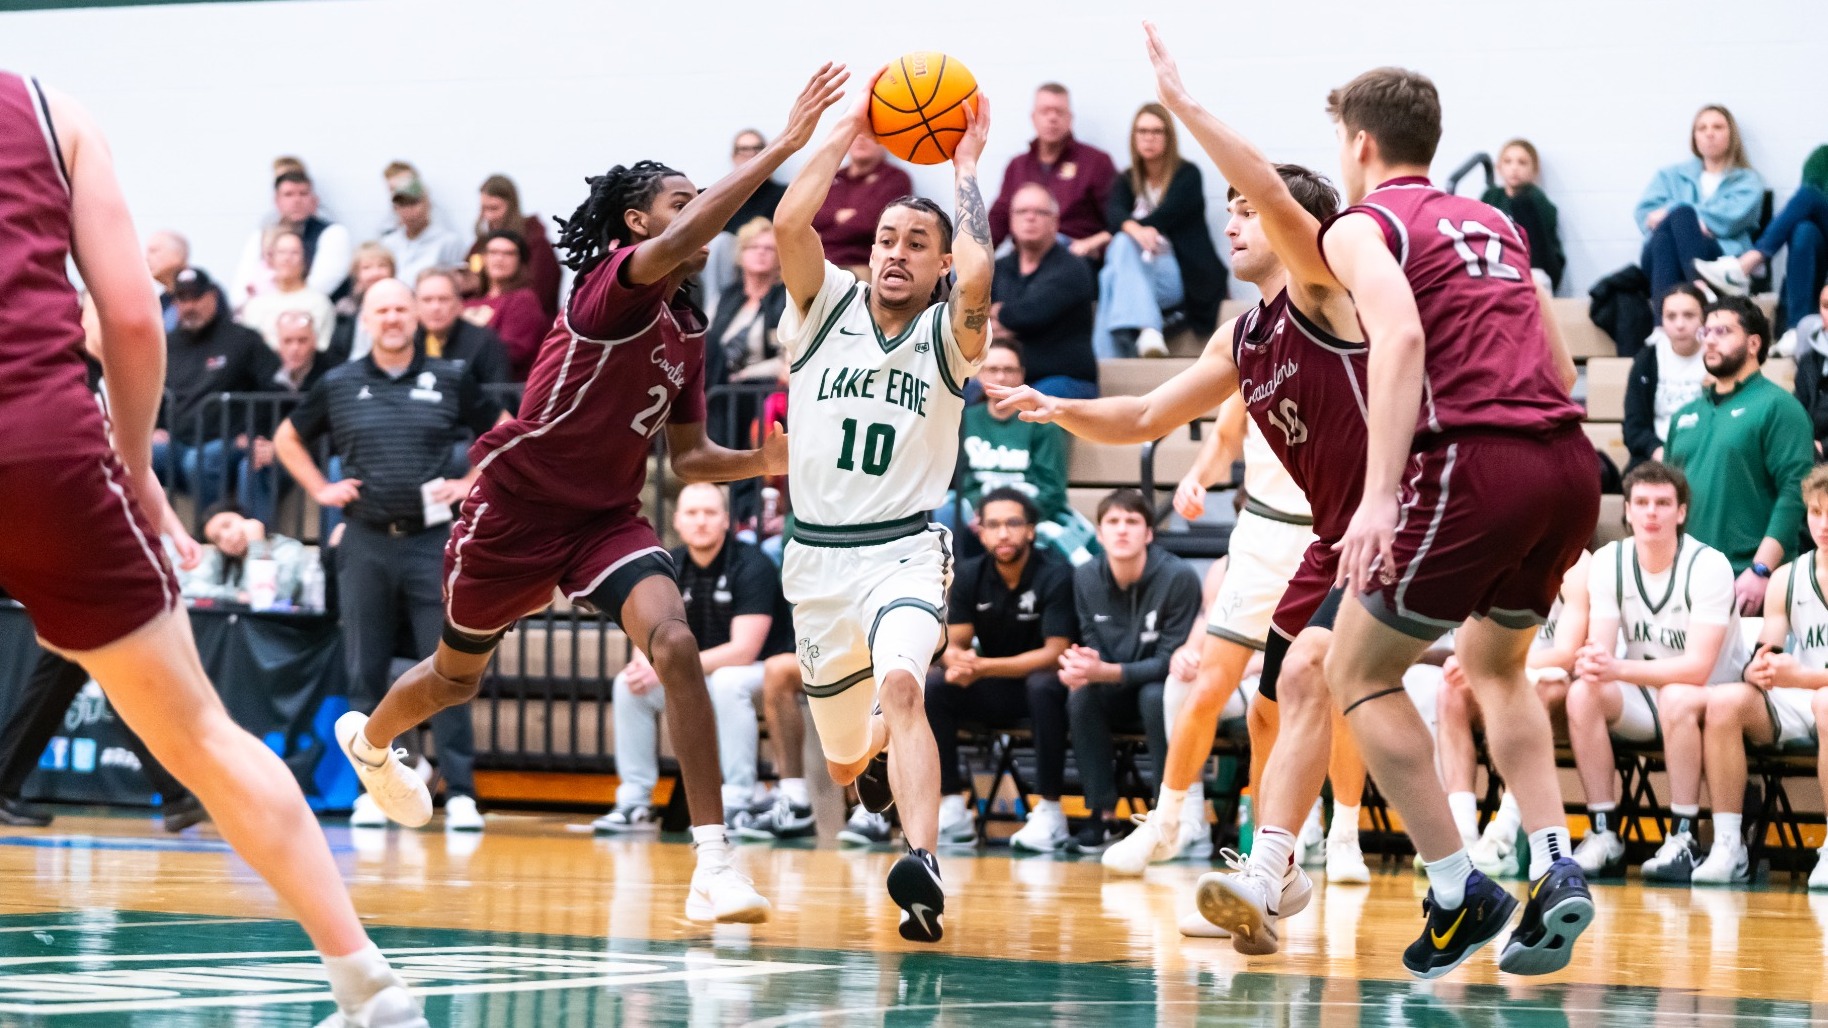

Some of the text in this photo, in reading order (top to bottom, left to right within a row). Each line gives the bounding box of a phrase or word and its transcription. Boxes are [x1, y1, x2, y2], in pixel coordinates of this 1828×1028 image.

[1437, 218, 1523, 281] 12
[817, 366, 930, 418] LAKE ERIE
[836, 417, 896, 477] 10
[1799, 622, 1828, 651] LAK
